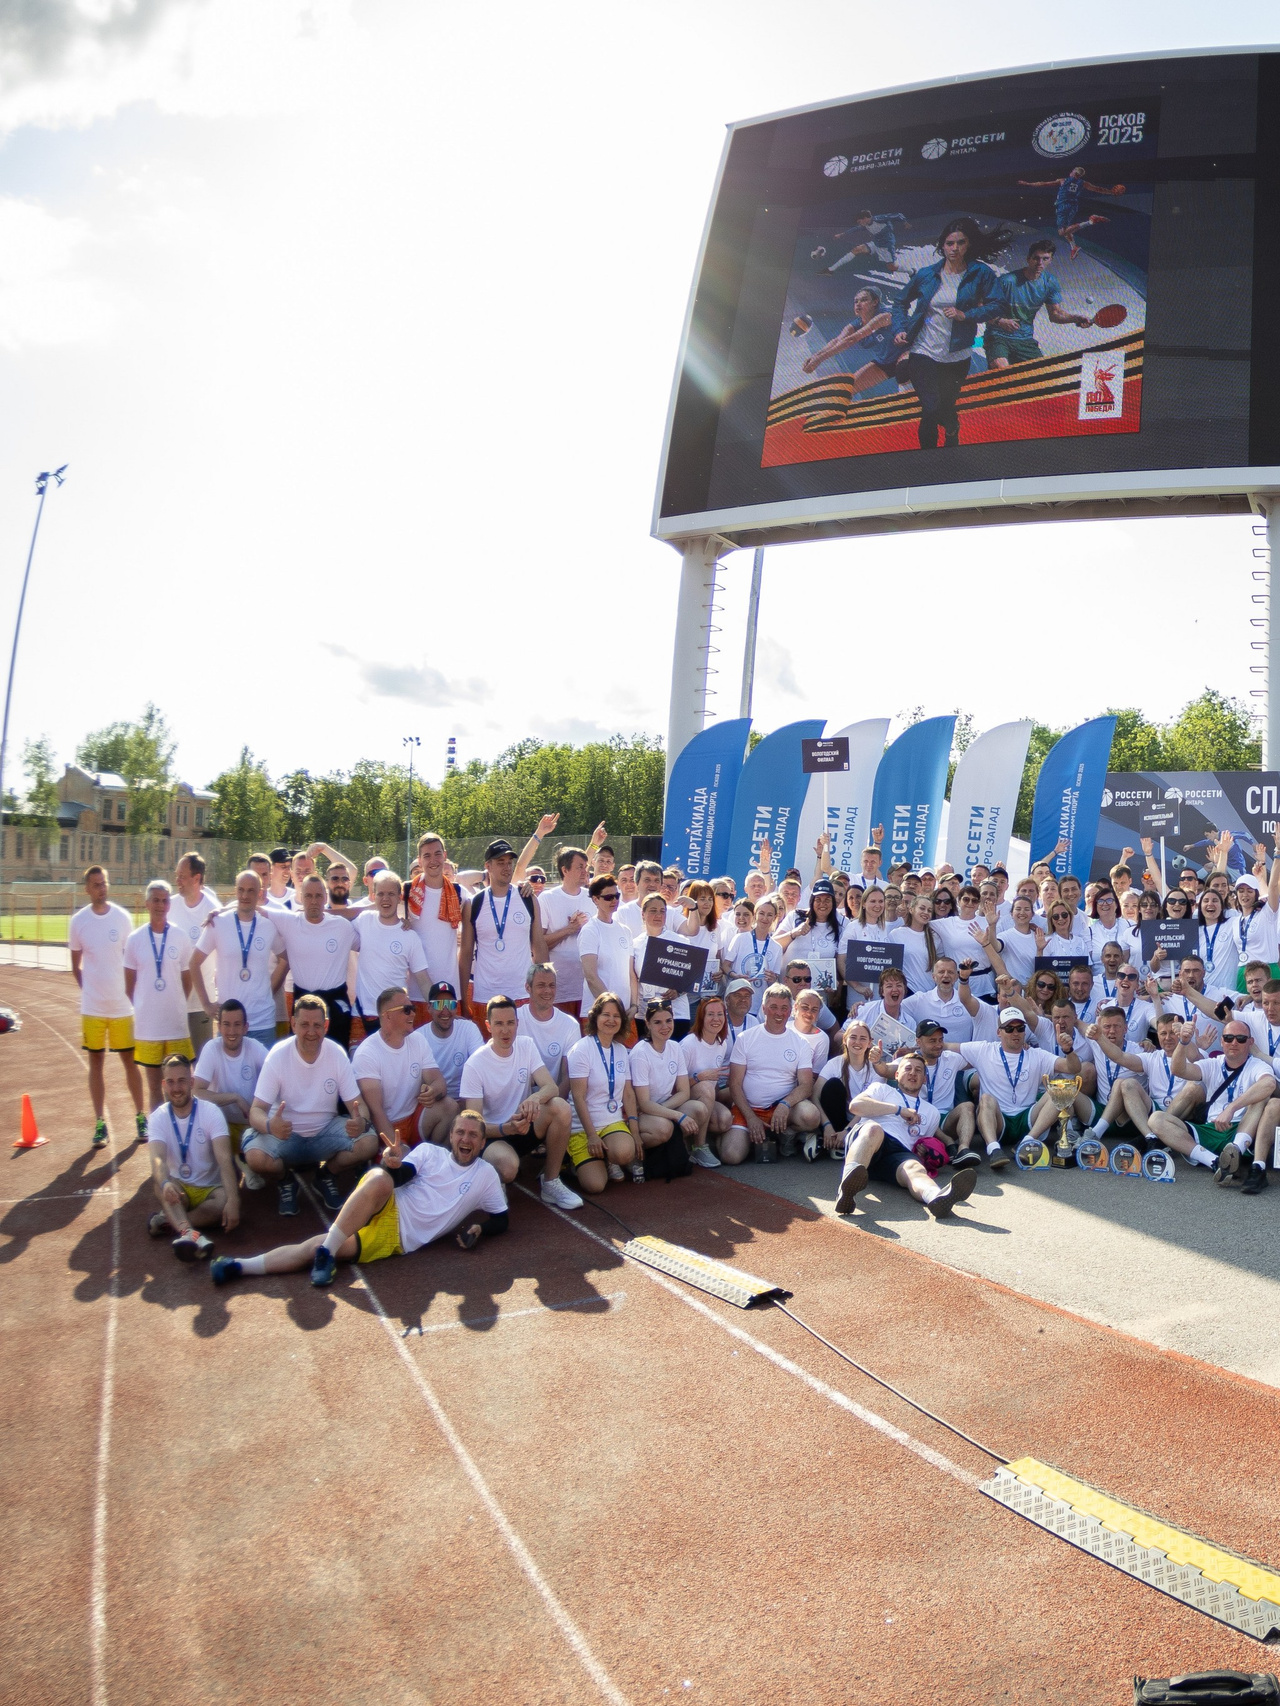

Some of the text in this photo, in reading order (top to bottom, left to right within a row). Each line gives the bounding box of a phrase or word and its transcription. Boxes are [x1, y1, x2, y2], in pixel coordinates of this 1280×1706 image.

[1099, 112, 1146, 128] ПСКОВ
[951, 132, 1005, 147] РОССЕТИ
[1097, 126, 1143, 146] 2025
[852, 147, 903, 164] РОССЕТИ
[850, 159, 900, 172] СЕВЕРО-ЗАПАД
[1115, 790, 1152, 799] РОССЕТИ
[1185, 790, 1223, 798] РОССЕТИ
[1071, 791, 1080, 815] СПОРТА
[687, 787, 708, 874] СПАРТАКИАДА
[702, 791, 718, 875] ПО ЛЕТНИМ ВИДАМ СПОРТА
[890, 804, 911, 866] ССЕТИ
[1055, 787, 1072, 873] СПАТАКИАДА
[1262, 820, 1276, 834] ПО
[769, 806, 791, 885] ВЕРО-ЗАПАД
[839, 806, 859, 873] ЕРО-ЗАПАД
[912, 804, 930, 871] ЕРО-ЗАПАД
[657, 957, 691, 970] МУРМАНСКИЙ
[856, 956, 893, 965] НОВГОРОДСКИЙ
[661, 967, 684, 977] ФИЛИАЛ
[1027, 1153, 1033, 1165] 1
